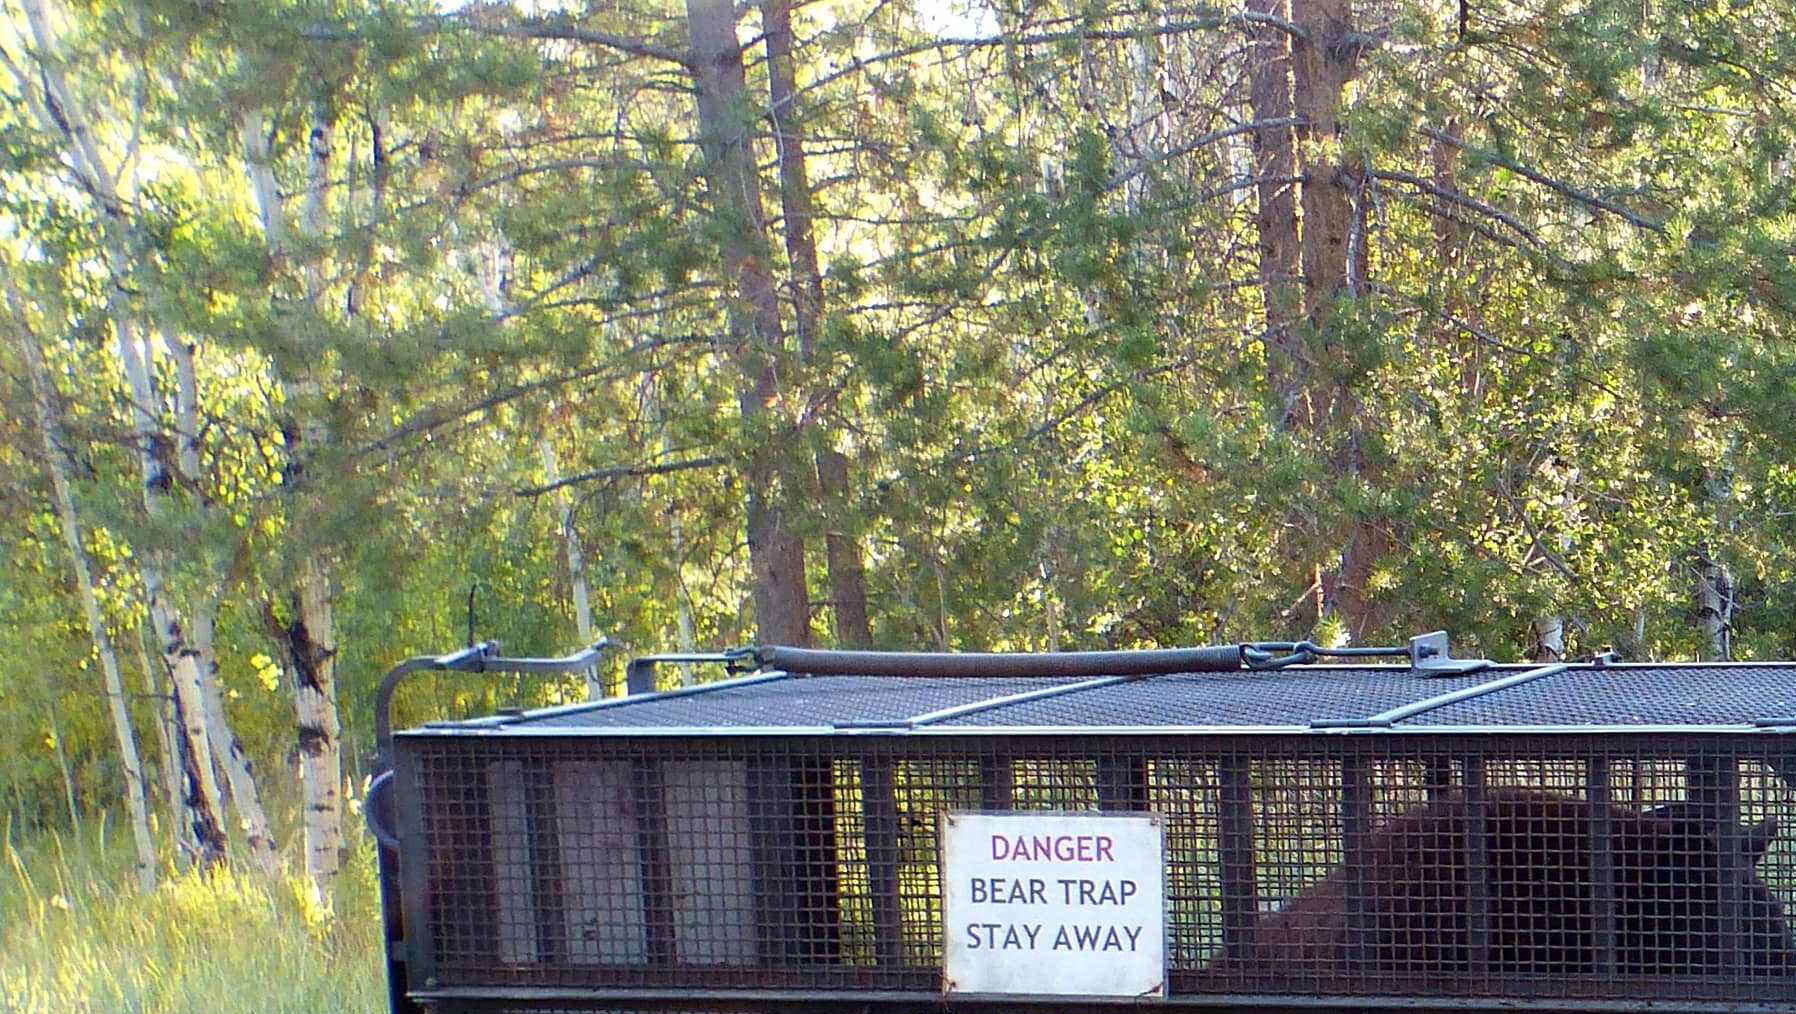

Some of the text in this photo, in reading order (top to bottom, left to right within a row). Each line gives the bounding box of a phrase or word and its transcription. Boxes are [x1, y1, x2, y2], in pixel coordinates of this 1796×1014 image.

[992, 835, 1114, 861] DANGER
[971, 878, 1136, 905] BEAR TRAP
[966, 924, 1142, 951] STAY AWAY
